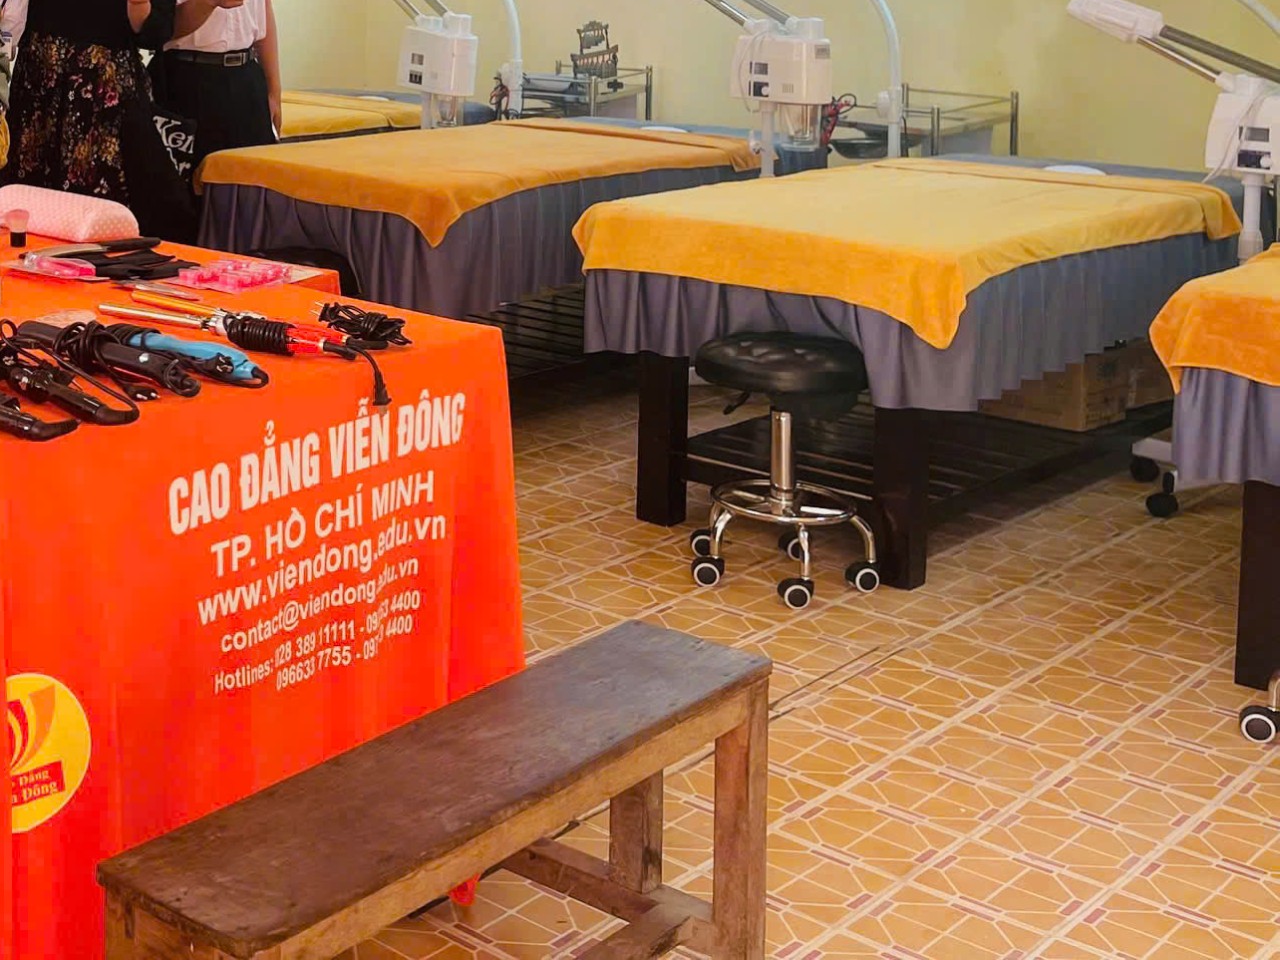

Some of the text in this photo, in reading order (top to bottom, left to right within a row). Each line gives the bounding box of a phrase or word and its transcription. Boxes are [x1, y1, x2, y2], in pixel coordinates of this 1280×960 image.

[168, 389, 466, 536] CAO ĐẲNG VIỄN ĐÔNG
[198, 515, 446, 626] www.viendong.edu.vn
[211, 533, 257, 578] TP.
[314, 482, 362, 538] CHÍ
[371, 470, 434, 519] MINH
[214, 656, 274, 695] Hotlines:
[296, 629, 316, 658] 389
[391, 590, 420, 616] 4400
[316, 645, 352, 669] 7755
[387, 614, 412, 639] 4400
